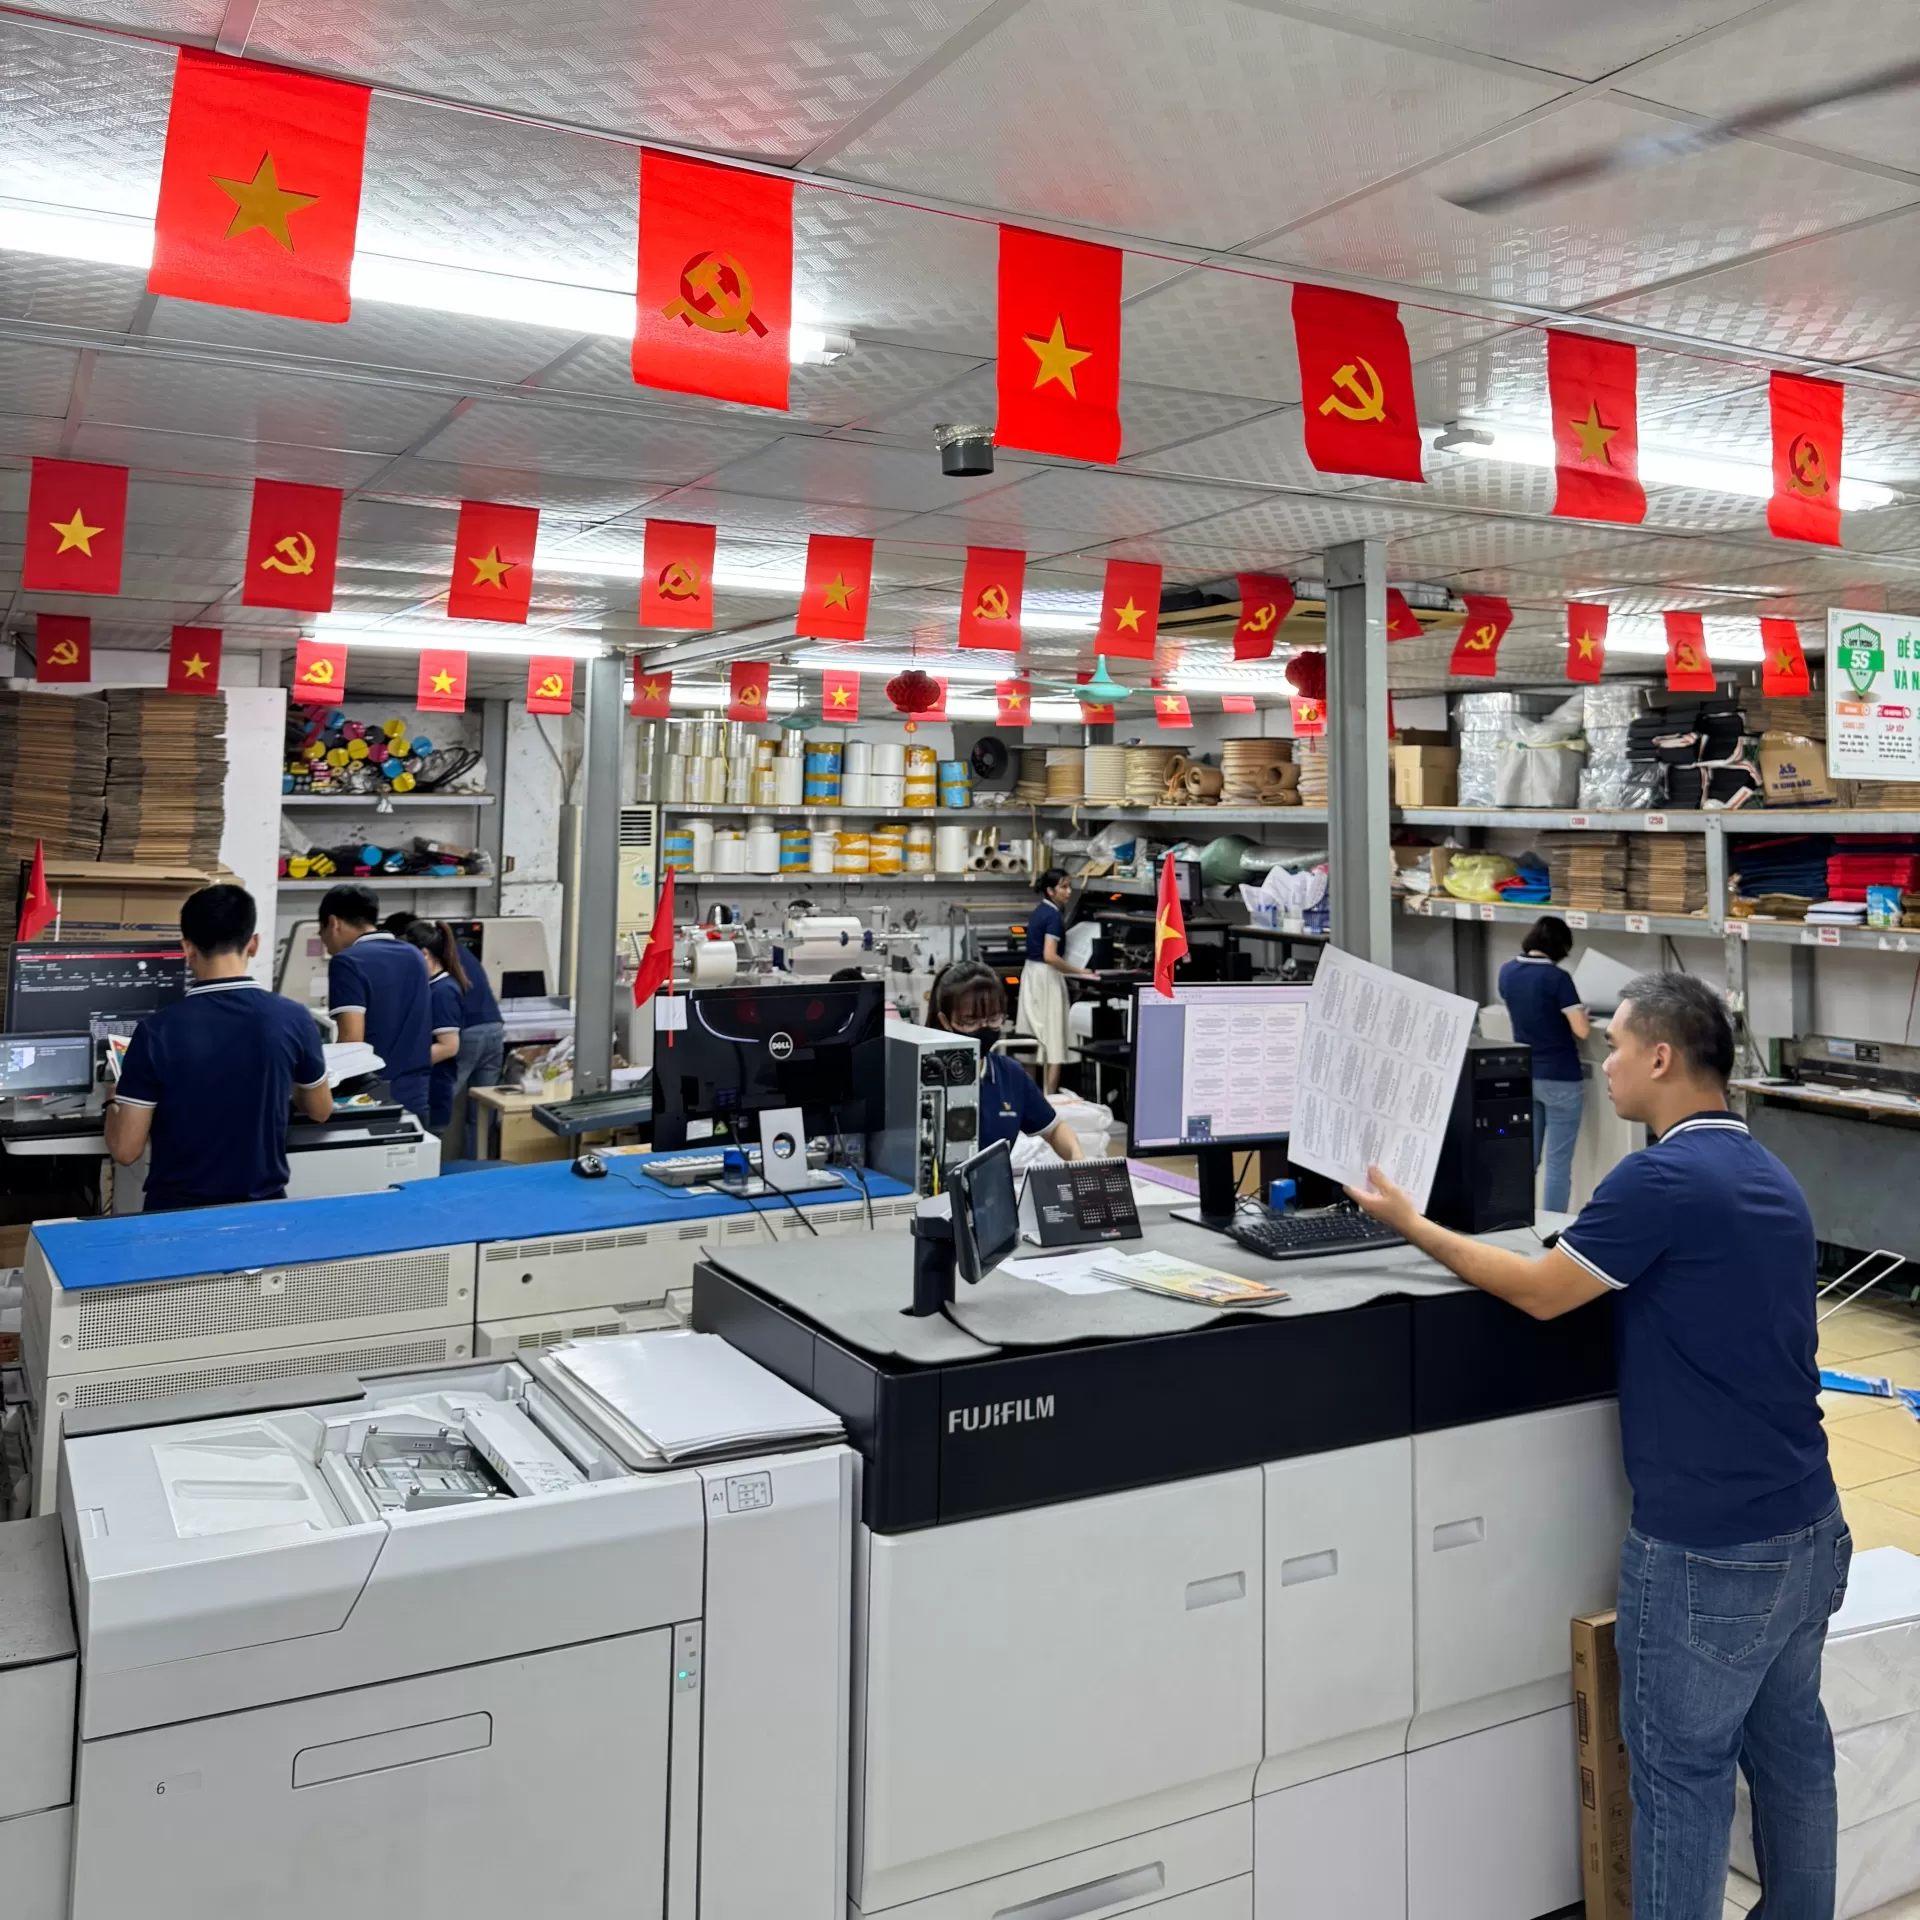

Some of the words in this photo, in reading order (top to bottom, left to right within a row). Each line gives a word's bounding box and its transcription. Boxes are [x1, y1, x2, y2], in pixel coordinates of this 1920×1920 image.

[1850, 650, 1872, 669] 5S
[1893, 665, 1908, 690] VÀ
[772, 1041, 791, 1050] DELL
[948, 1394, 1055, 1435] FUJIFILM
[712, 1491, 724, 1503] A1
[156, 1781, 166, 1795] 6
